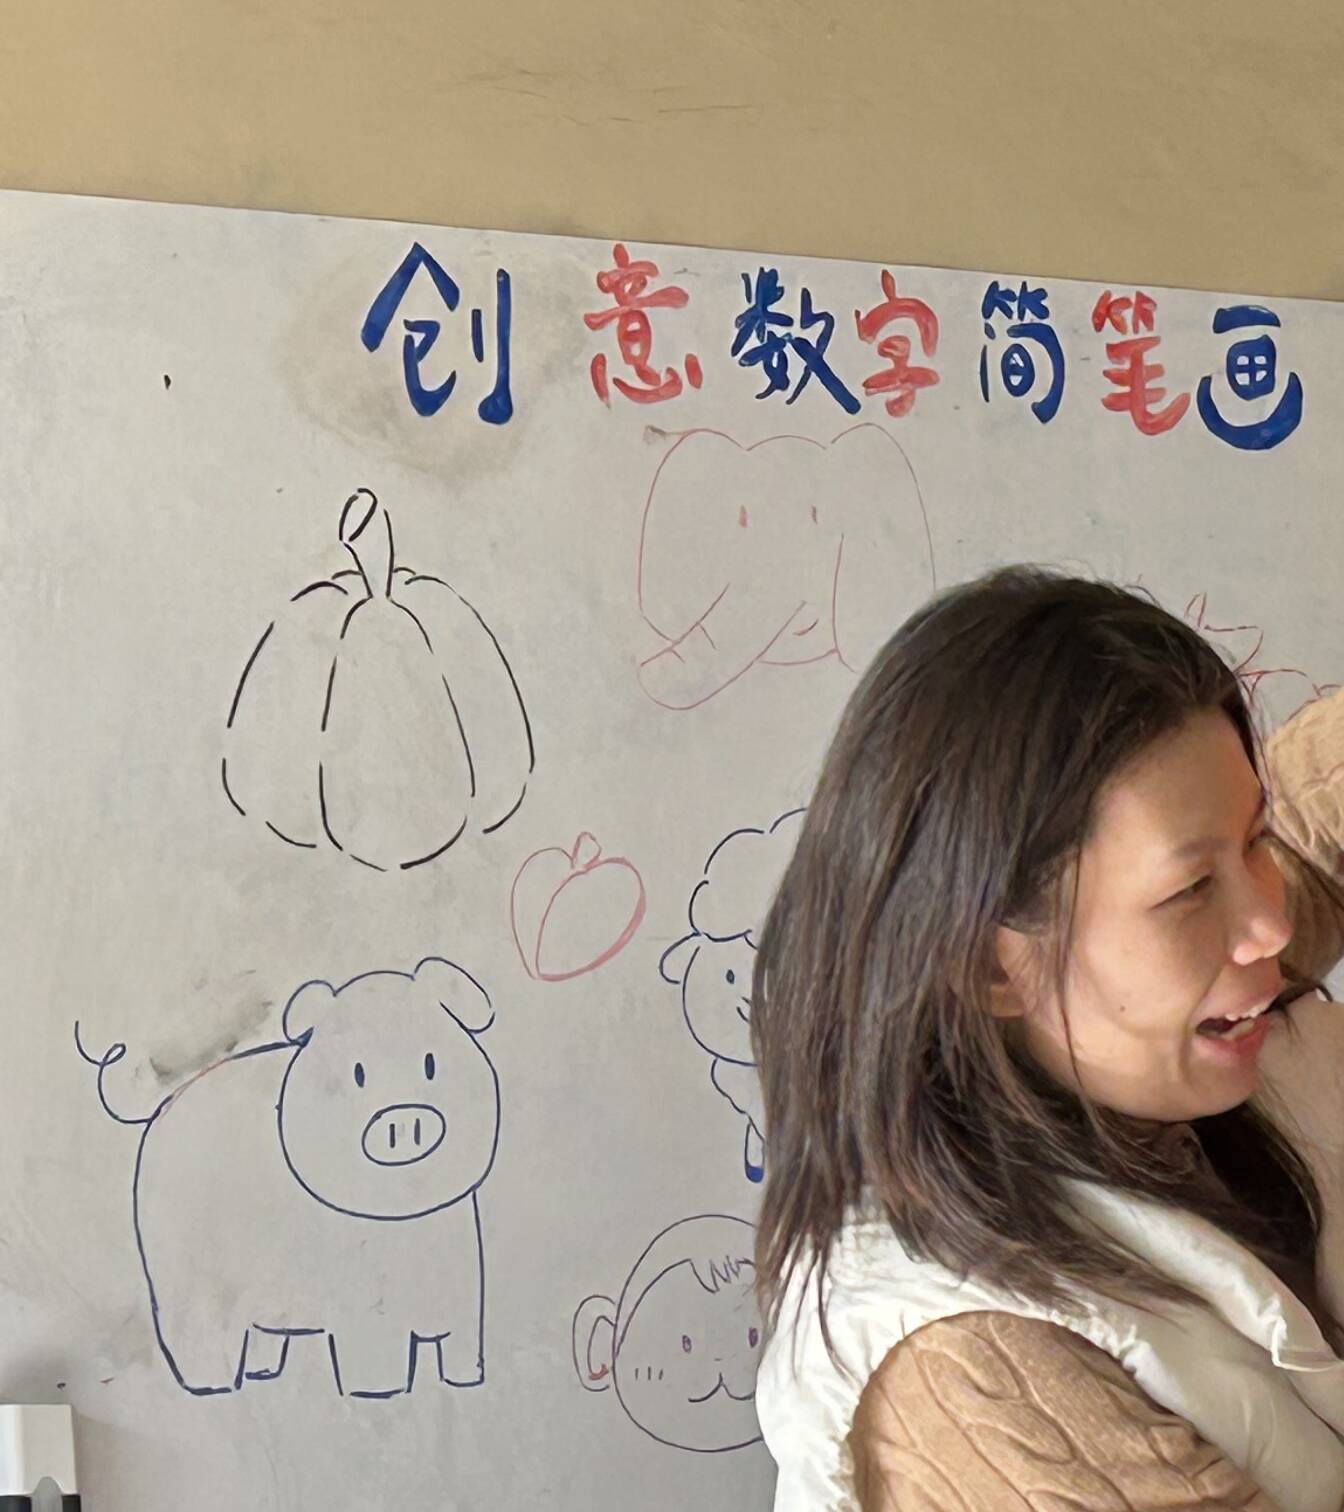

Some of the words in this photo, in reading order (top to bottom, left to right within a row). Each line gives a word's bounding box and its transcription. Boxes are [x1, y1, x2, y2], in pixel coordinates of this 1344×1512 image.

[362, 243, 1303, 450] 创意数字简笔画
